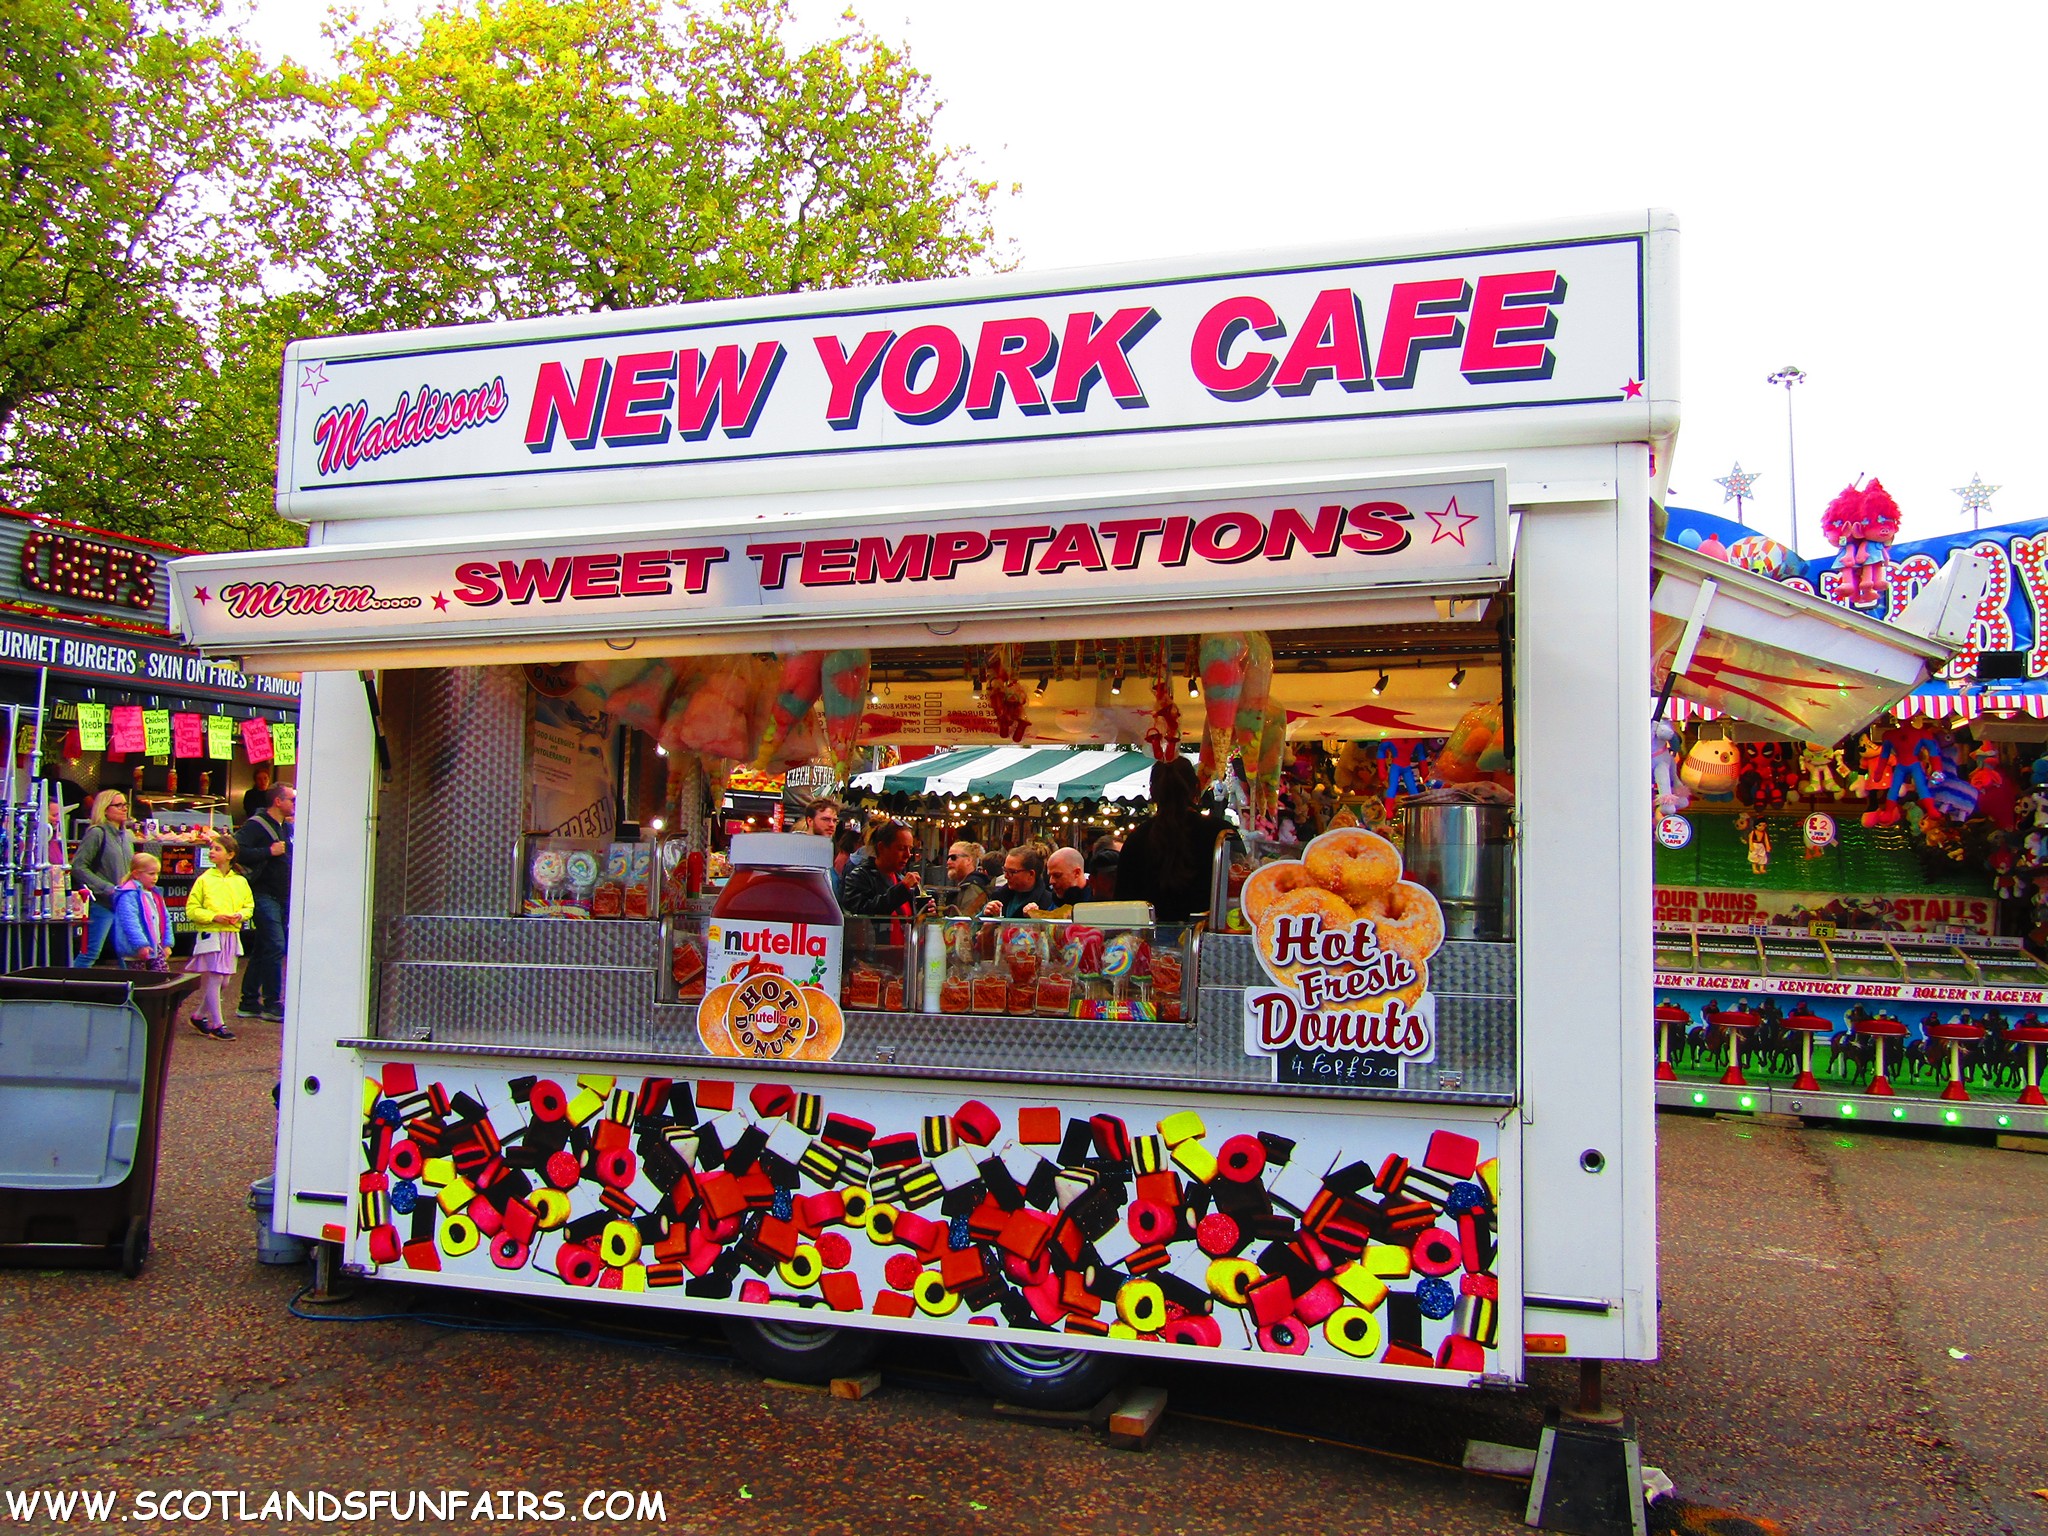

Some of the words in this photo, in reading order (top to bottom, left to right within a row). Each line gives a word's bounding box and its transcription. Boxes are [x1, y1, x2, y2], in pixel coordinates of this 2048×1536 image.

[524, 341, 787, 454] NEW
[813, 306, 1161, 430] YORK
[1191, 269, 1567, 398] CAFE
[314, 375, 508, 476] Maddisons
[452, 546, 730, 606] SWEET
[745, 500, 1415, 590] TEMPTATIONS
[22, 531, 158, 610] CHEFS
[0, 630, 60, 663] URMET
[63, 639, 136, 675] BURGERS
[147, 653, 183, 681] SKIN
[186, 659, 205, 683] ON
[209, 666, 248, 689] FRIES
[257, 675, 300, 696] FAMOU
[148, 727, 166, 736] Zinger
[534, 748, 572, 766] NTOLERANCES
[786, 766, 811, 787] CZECH
[812, 765, 836, 786] STREE
[1654, 907, 1692, 922] GER
[1704, 892, 1758, 911] WINS
[1893, 898, 1988, 925] STALLS
[724, 922, 828, 957] nutella
[1274, 916, 1377, 962] Hot
[1816, 928, 1828, 937] £5
[738, 980, 798, 1011] HOT
[1299, 953, 1412, 1006] Fresh
[1655, 974, 1682, 986] L'EM
[1696, 976, 1751, 989] RACE'EM
[1778, 981, 1852, 996] KENTUCKY
[1855, 984, 1901, 998] DERBY
[1912, 987, 1967, 1000] ROLL'EM
[1983, 990, 2043, 1004] RACE'EM
[748, 1011, 787, 1025] nutella
[1252, 992, 1424, 1052] Donuts
[735, 1015, 802, 1056] DONUTS
